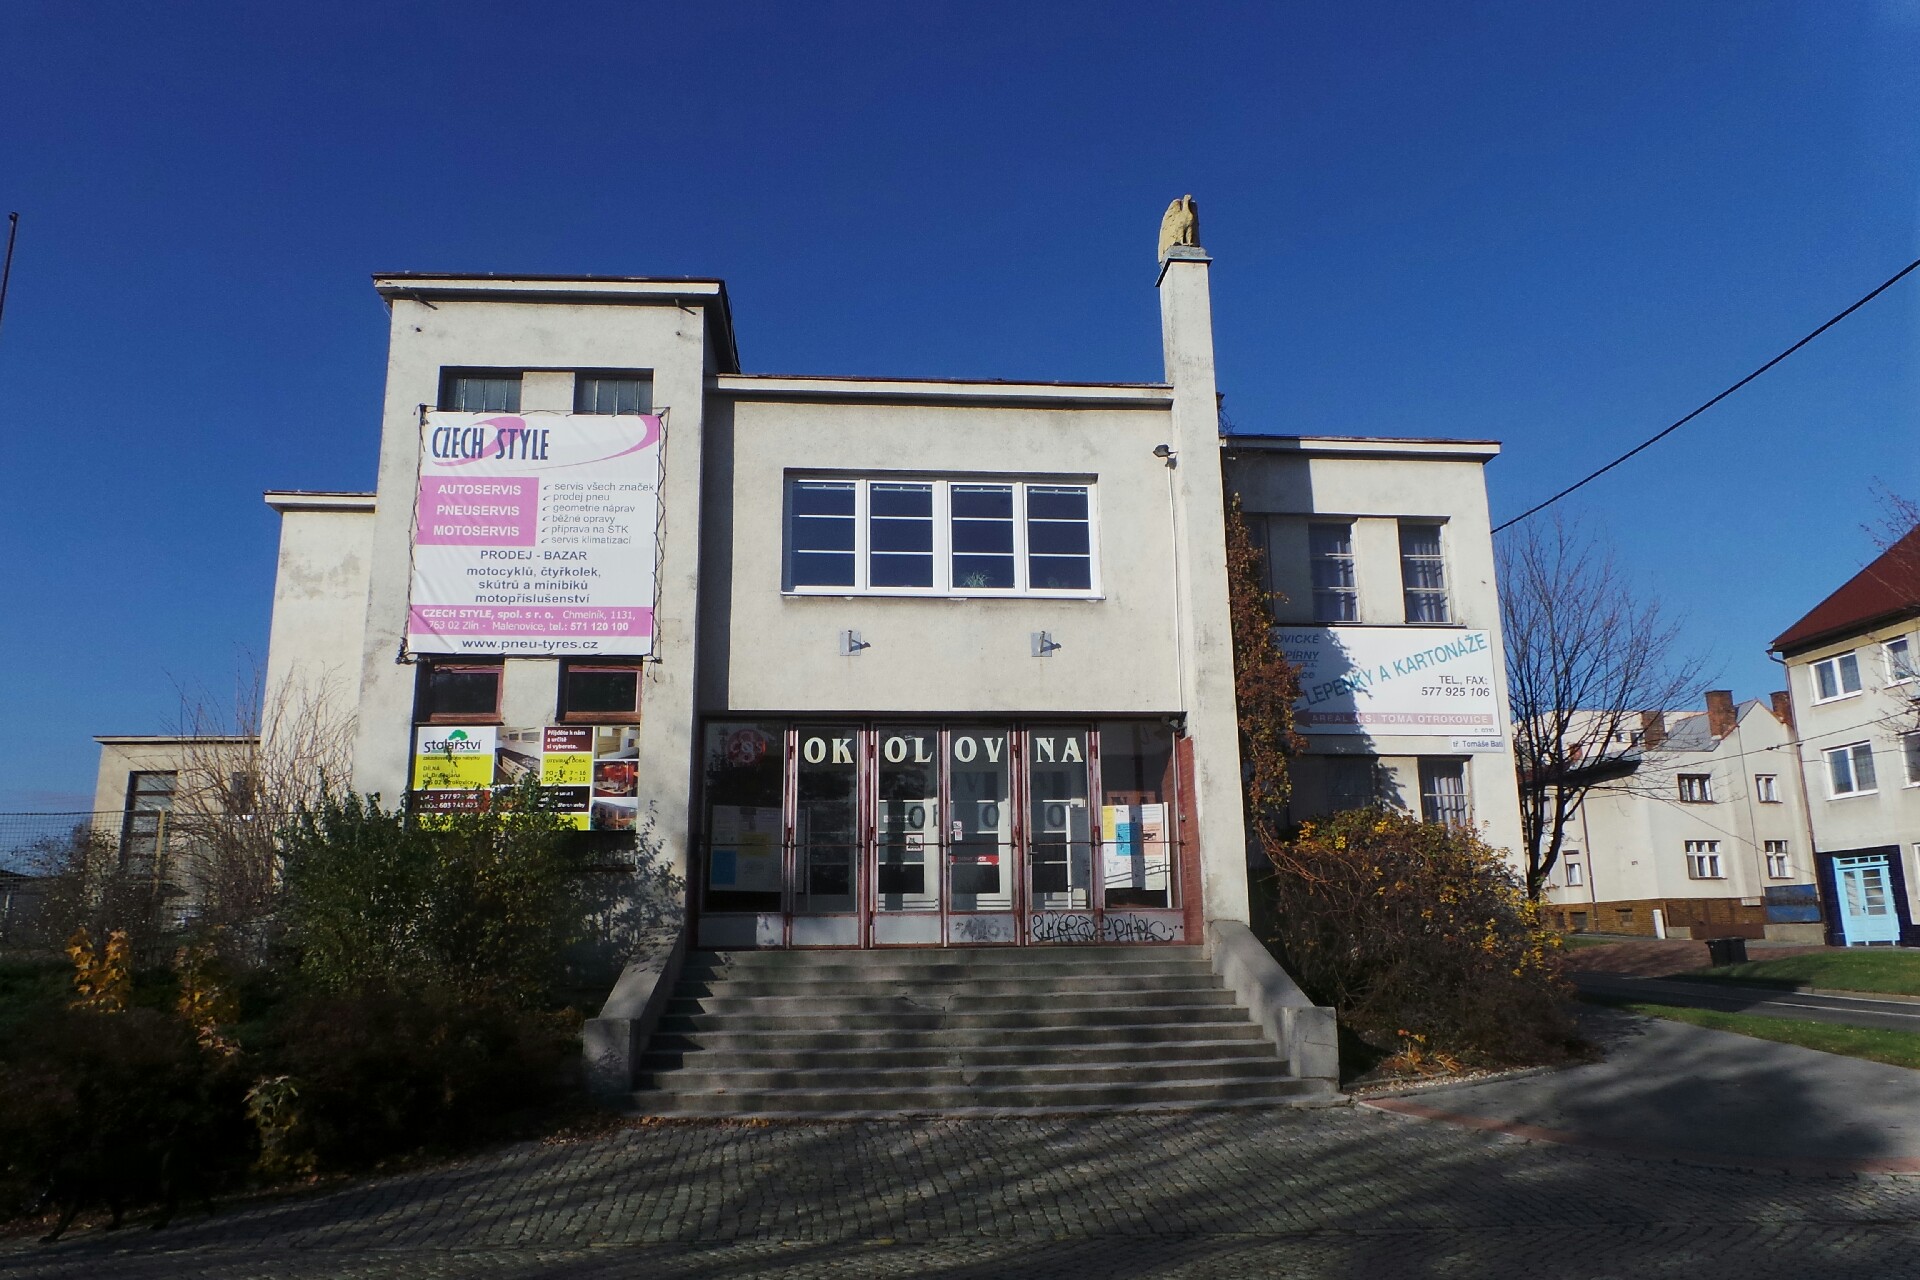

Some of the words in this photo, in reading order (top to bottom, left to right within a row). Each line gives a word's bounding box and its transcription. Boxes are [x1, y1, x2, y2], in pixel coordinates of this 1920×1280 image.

[432, 427, 485, 459] CZECH
[495, 428, 550, 460] STYLE
[438, 484, 522, 495] AUTOSERVIS
[587, 482, 616, 491] všech
[620, 482, 654, 491] značek
[553, 492, 583, 502] prodej
[586, 494, 610, 502] pneu
[436, 504, 520, 516] PNEUSERVIS
[583, 516, 615, 524] opravy
[433, 525, 520, 536] MOTOSERVIS
[608, 525, 629, 534] STK
[480, 550, 532, 560] PRODEJ
[544, 551, 588, 560] BAZAR
[466, 566, 537, 578] motocyklů,
[541, 567, 601, 578] čtyřkolek,
[478, 580, 519, 589] skútrů
[534, 580, 588, 590] minibiků
[422, 609, 456, 617] CZECH
[459, 609, 494, 619] STYLE,
[497, 610, 522, 620] spol.
[448, 621, 459, 630] 02
[462, 620, 479, 630] Zlín
[492, 622, 546, 632] Malenovice,
[570, 622, 587, 631] 571
[591, 622, 608, 631] 120
[612, 623, 629, 631] 100
[462, 640, 599, 650] www.pneu-tyres.cz
[1304, 669, 1373, 706] LEPENKY
[1379, 665, 1391, 682] A
[1393, 633, 1488, 676] KARTONÁŽE
[1421, 687, 1442, 696] 577
[1445, 687, 1466, 696] 925
[1471, 688, 1490, 696] 106
[1381, 714, 1413, 722] TOMA
[1418, 714, 1488, 723] OTROKOVICE
